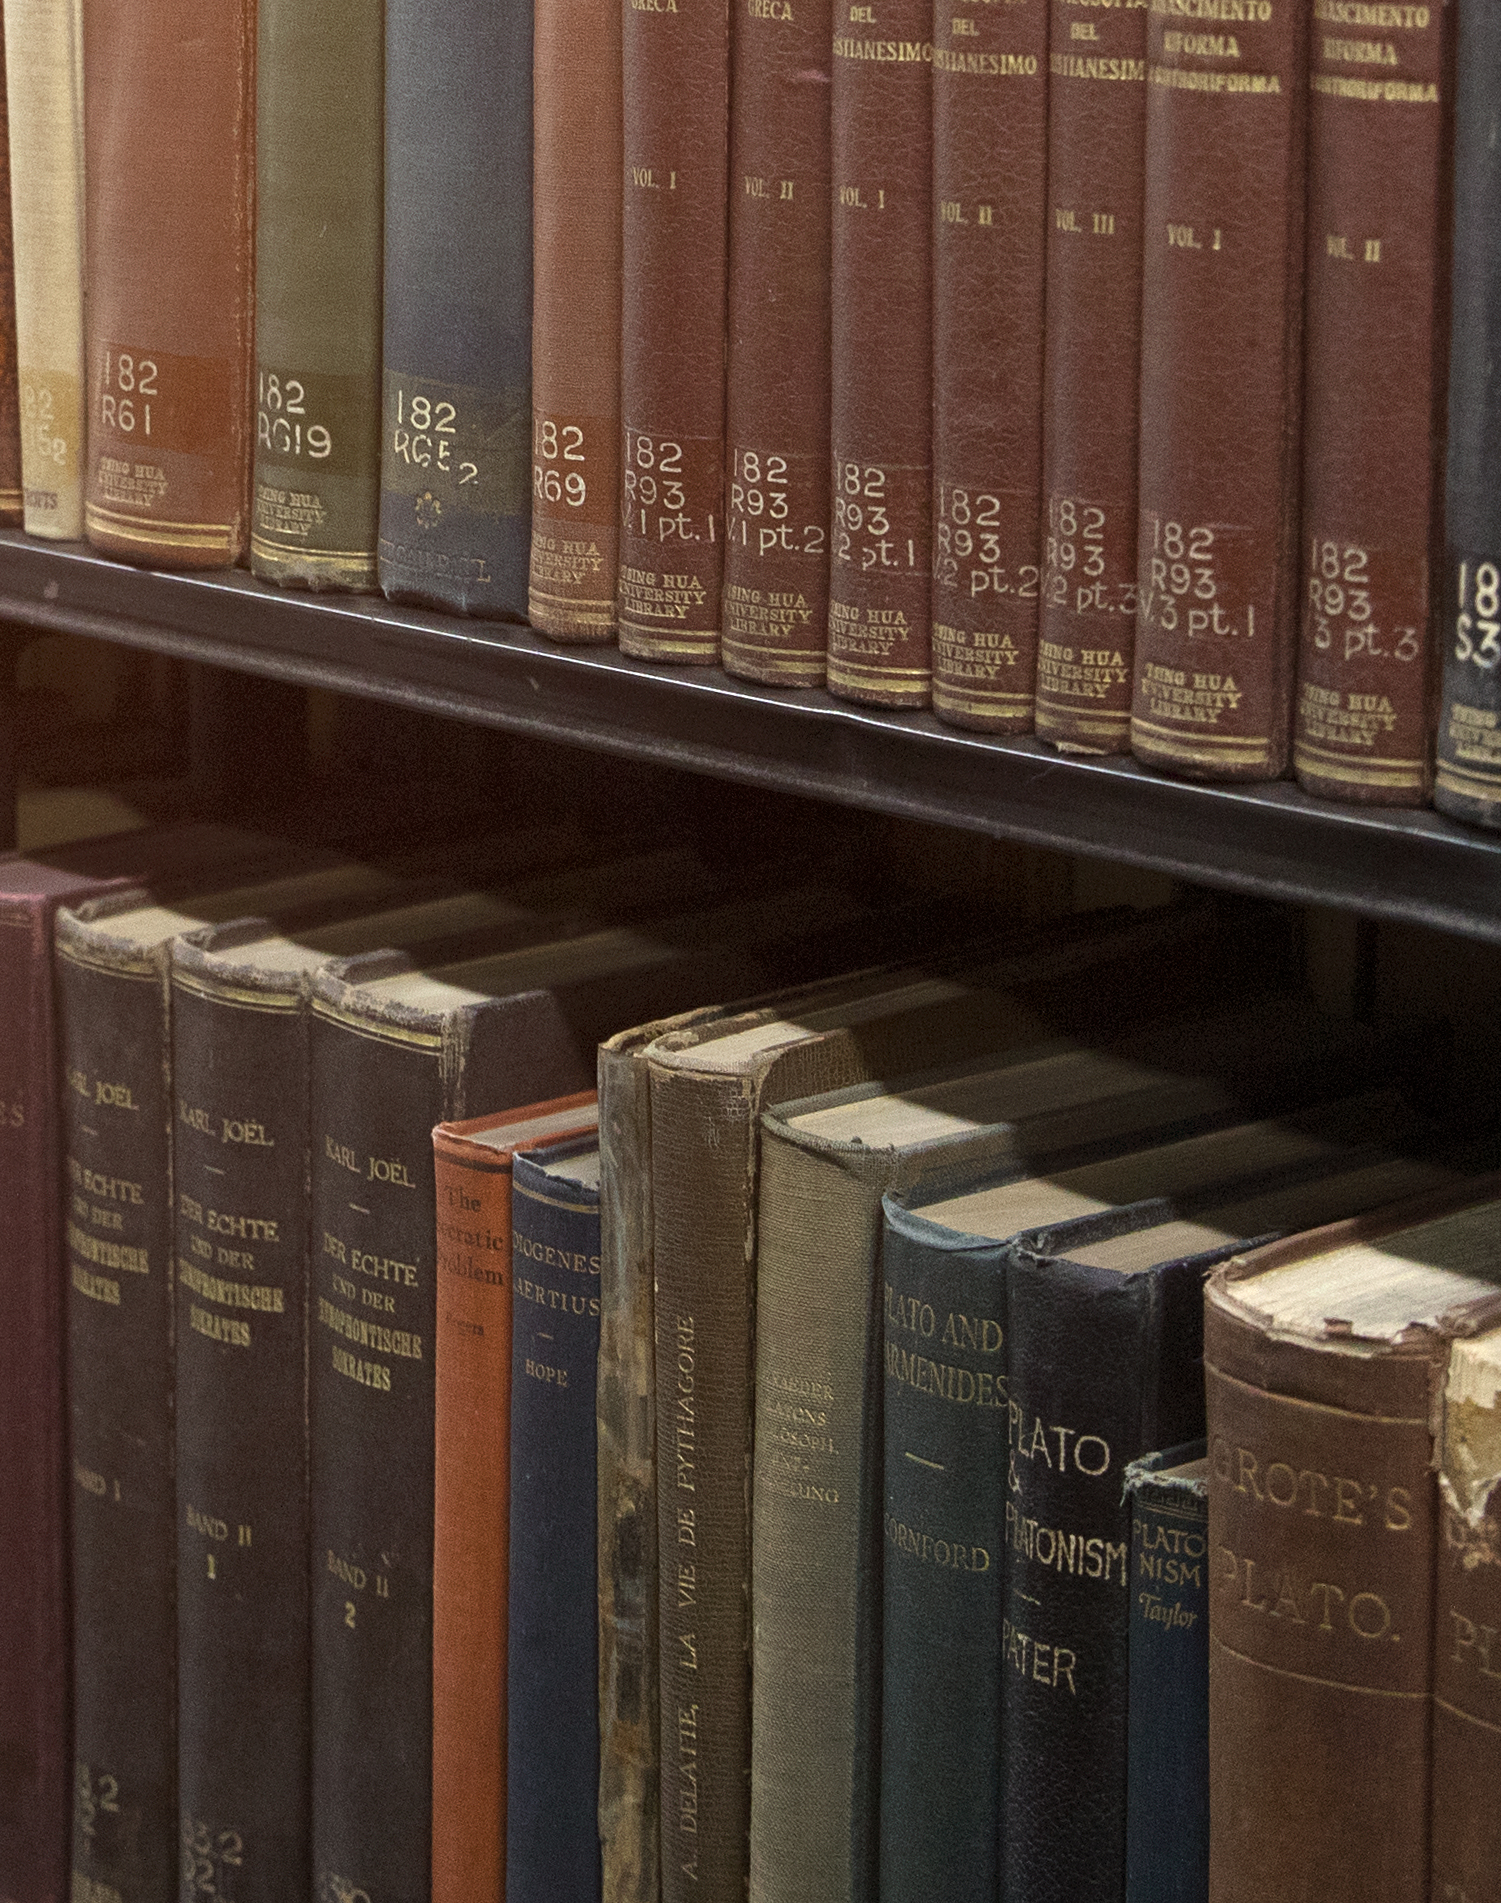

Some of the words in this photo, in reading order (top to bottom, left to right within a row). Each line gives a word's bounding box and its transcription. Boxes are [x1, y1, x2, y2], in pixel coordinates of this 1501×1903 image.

[849, 4, 877, 25] DEL
[951, 16, 980, 37] DEL
[1070, 21, 1100, 42] DEL
[632, 166, 660, 190] VOL.
[744, 175, 772, 199] VOL.
[839, 185, 867, 209] VOL.
[103, 351, 158, 395] 182
[101, 395, 152, 436] R61
[535, 421, 586, 462] 182
[626, 431, 683, 473] 182
[734, 447, 788, 485] 182
[836, 461, 887, 498] 182
[534, 465, 587, 508] R69
[625, 469, 686, 510] R93
[730, 485, 789, 519] R93
[658, 514, 715, 543] pt.1
[835, 498, 891, 535] R93
[759, 526, 825, 556] pt.2
[663, 575, 702, 589] HUA
[1151, 560, 1217, 600] R93
[624, 596, 687, 619] LIBRARY
[769, 593, 806, 609] HUA
[871, 610, 907, 625] HUA
[730, 615, 793, 639] LIBRARY
[972, 633, 1015, 650] HUA
[180, 1100, 216, 1136] KARL
[221, 1116, 274, 1147] JOËL
[324, 1134, 361, 1174] KARL
[367, 1153, 416, 1189] JOËL
[445, 1184, 482, 1214] The
[207, 1205, 280, 1243] ECHTE
[218, 1244, 256, 1271] DER
[351, 1245, 419, 1287] ECHTE
[513, 1233, 601, 1276] DIOGENES
[361, 1287, 396, 1314] DER
[942, 1311, 1004, 1354] AND
[524, 1358, 569, 1389] HOPE
[675, 1314, 695, 1492] PYTHAGORE
[1008, 1401, 1111, 1477] PLATO
[678, 1507, 695, 1547] DE
[1005, 1500, 1128, 1587] PLATONISM
[678, 1561, 696, 1609] VIE
[1138, 1592, 1198, 1632] Taylor
[681, 1633, 697, 1669] LA
[1002, 1617, 1077, 1696] PATER
